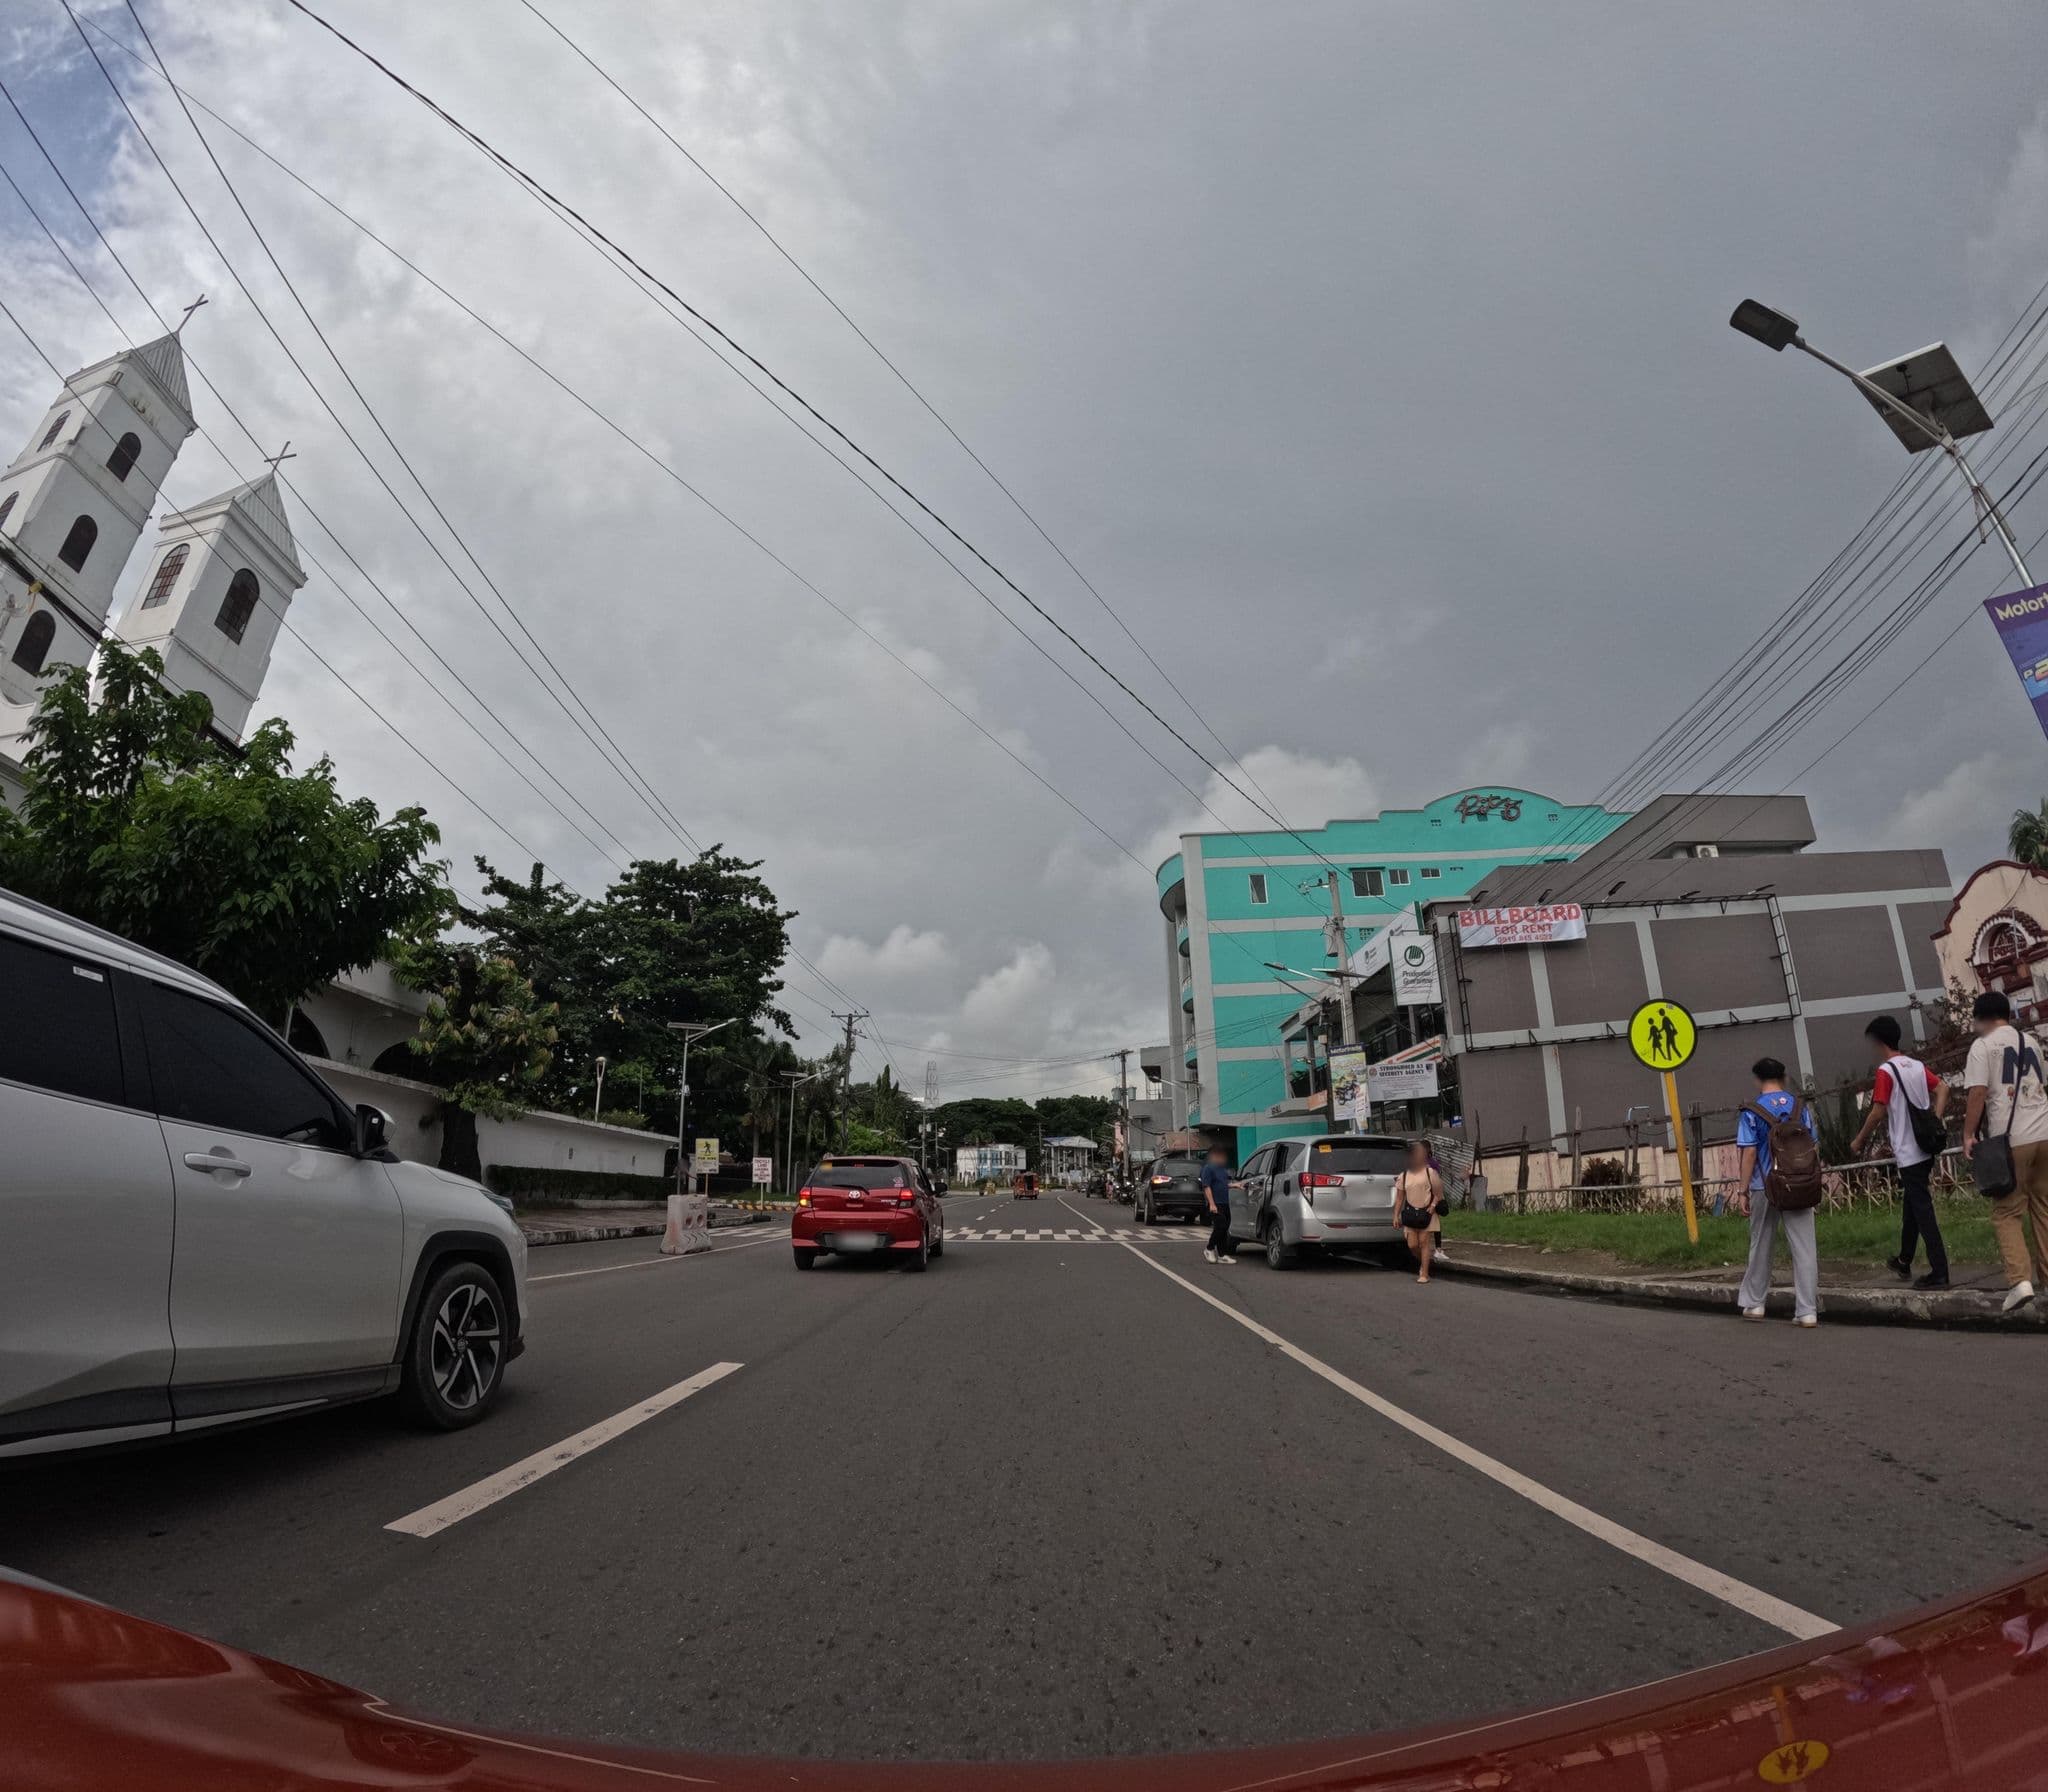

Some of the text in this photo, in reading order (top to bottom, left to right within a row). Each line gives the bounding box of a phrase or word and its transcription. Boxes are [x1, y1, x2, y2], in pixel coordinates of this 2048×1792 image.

[1459, 904, 1581, 928] BILLBOARD
[1494, 923, 1553, 937] FOR RENT
